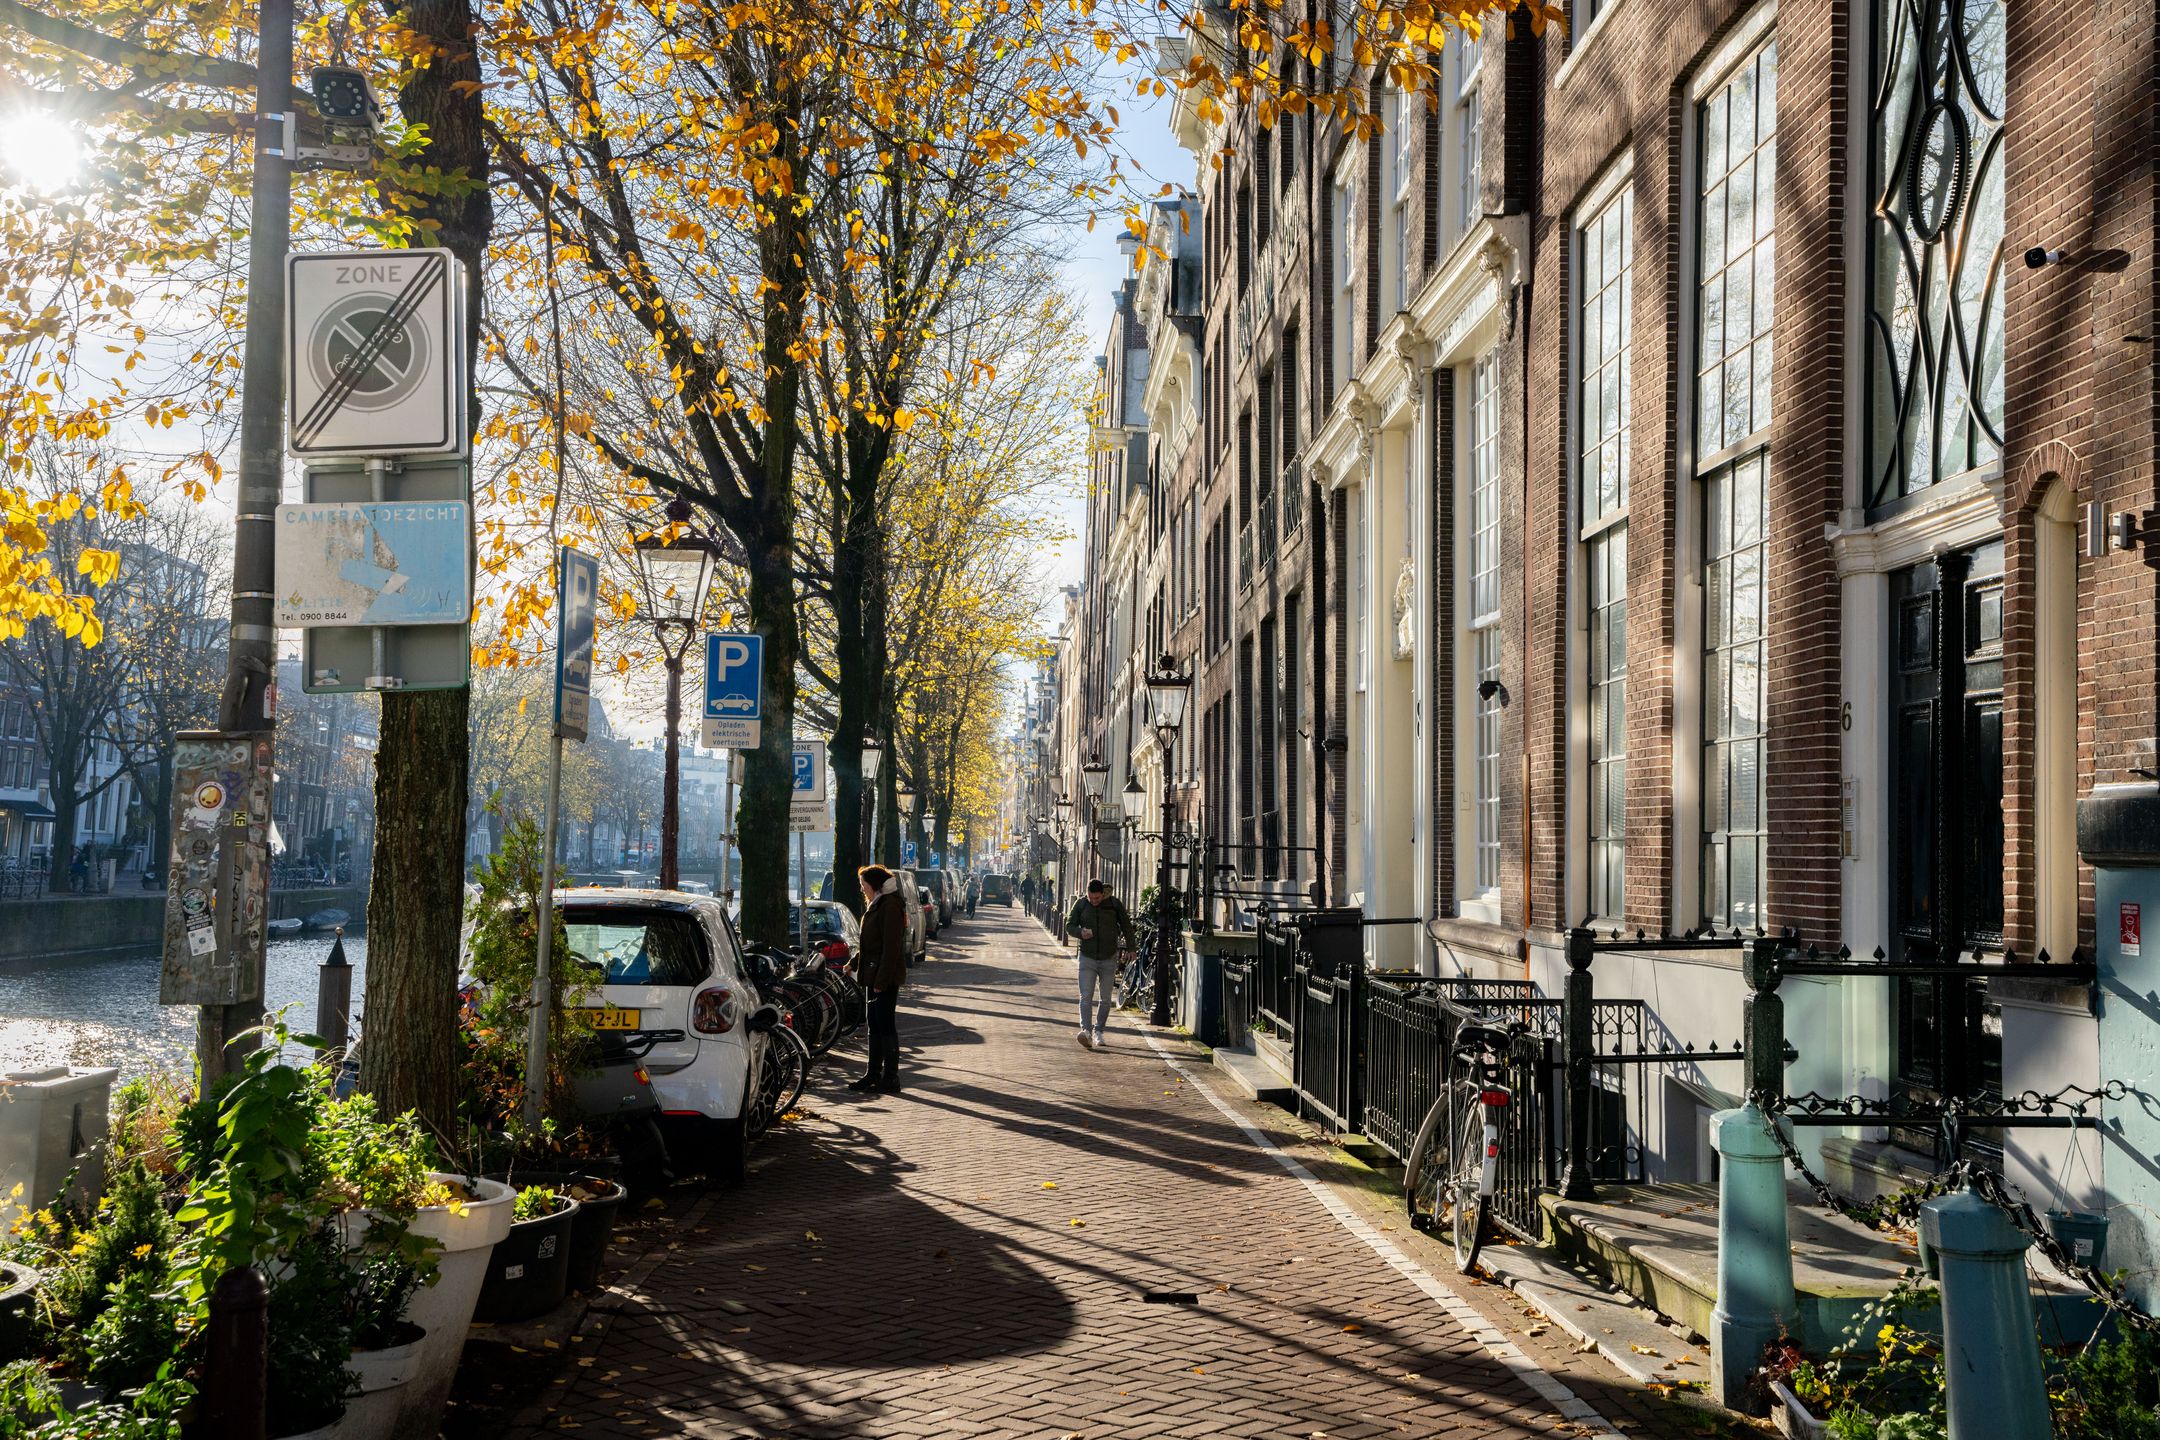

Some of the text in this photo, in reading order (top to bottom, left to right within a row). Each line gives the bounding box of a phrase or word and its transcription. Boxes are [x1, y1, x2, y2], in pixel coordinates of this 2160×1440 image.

[335, 265, 402, 284] ZONE
[572, 563, 590, 630] P
[281, 611, 347, 621] Tel. 0900 8844
[718, 640, 749, 682] P
[1842, 701, 1852, 732] 6
[718, 720, 746, 730] Opladen
[712, 729, 751, 738] elektrische
[712, 739, 750, 748] voertuigen
[794, 756, 808, 775] P
[905, 843, 914, 855] P
